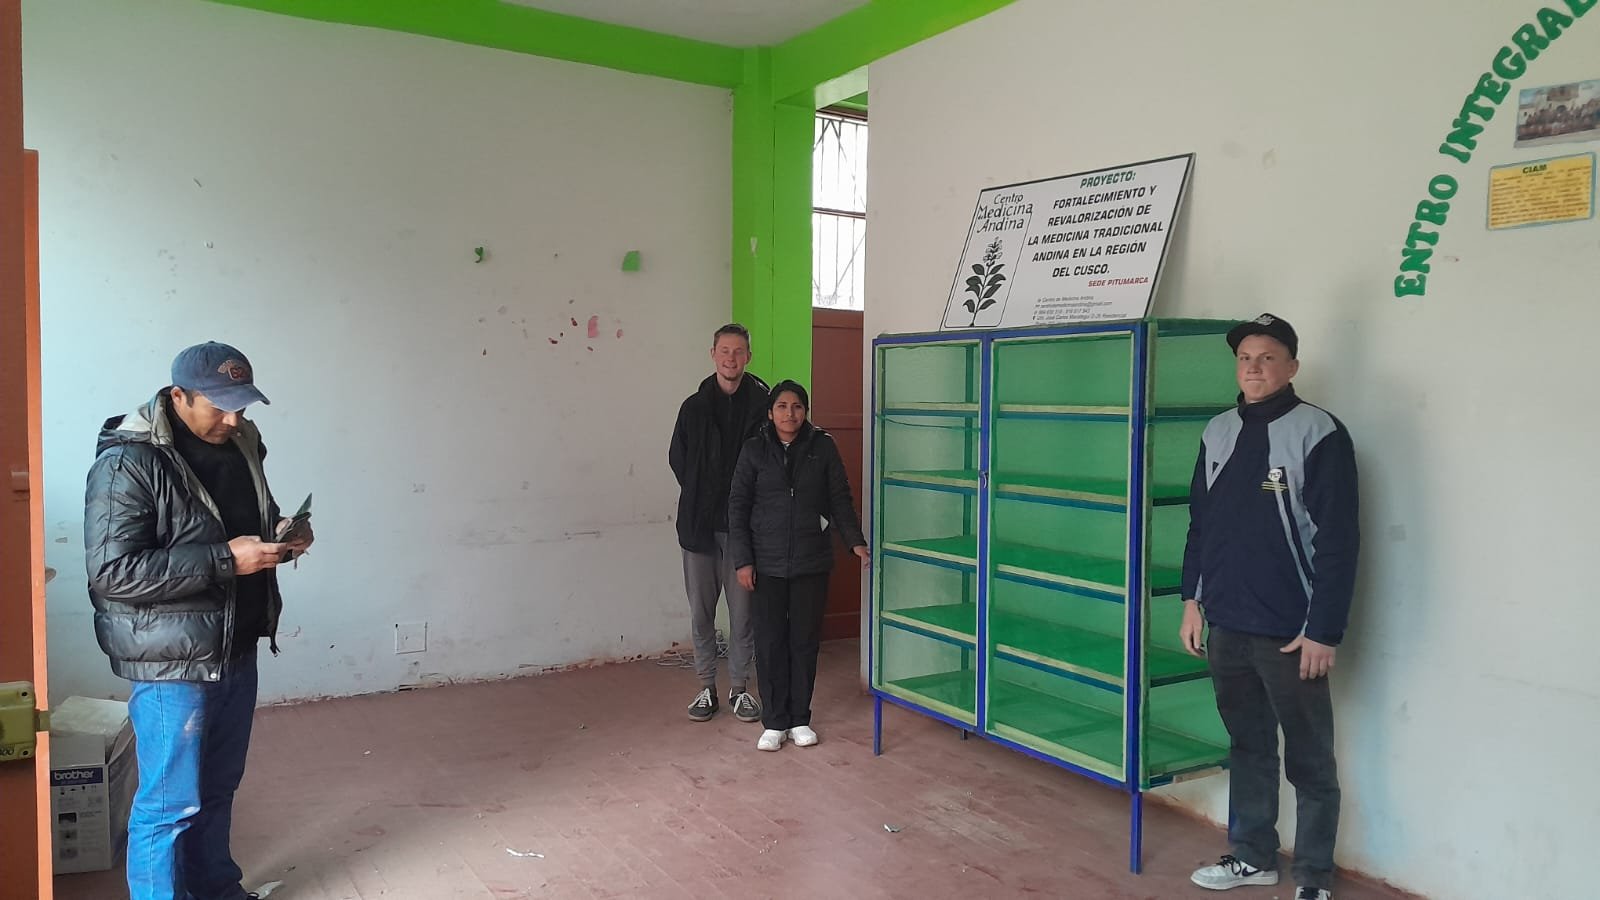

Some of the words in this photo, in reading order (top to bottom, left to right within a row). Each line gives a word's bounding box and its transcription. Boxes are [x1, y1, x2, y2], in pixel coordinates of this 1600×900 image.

[1522, 164, 1548, 174] CIAM
[1080, 171, 1136, 188] PROYECTO:
[993, 192, 1024, 205] Centro
[1053, 186, 1146, 210] FORTALECIMIENTO
[1149, 184, 1158, 196] Y
[977, 203, 1033, 220] Medicina
[1047, 204, 1134, 228] REVALORIZACIÓN
[1136, 204, 1152, 216] DE
[976, 217, 1025, 234] Andina
[1027, 235, 1039, 246] LA
[1041, 229, 1090, 244] MEDICINA
[1093, 221, 1164, 239] TRADICIONAL
[1394, 174, 1459, 298] ENTRO
[1031, 249, 1070, 262] ANDINA
[1072, 247, 1087, 259] EN
[1089, 246, 1102, 257] LA
[1105, 239, 1147, 256] REGIÓN
[1052, 267, 1071, 277] DEL
[1073, 263, 1110, 276] CUSCO.
[1107, 277, 1149, 286] PITUMARCA
[54, 769, 94, 780] brother
